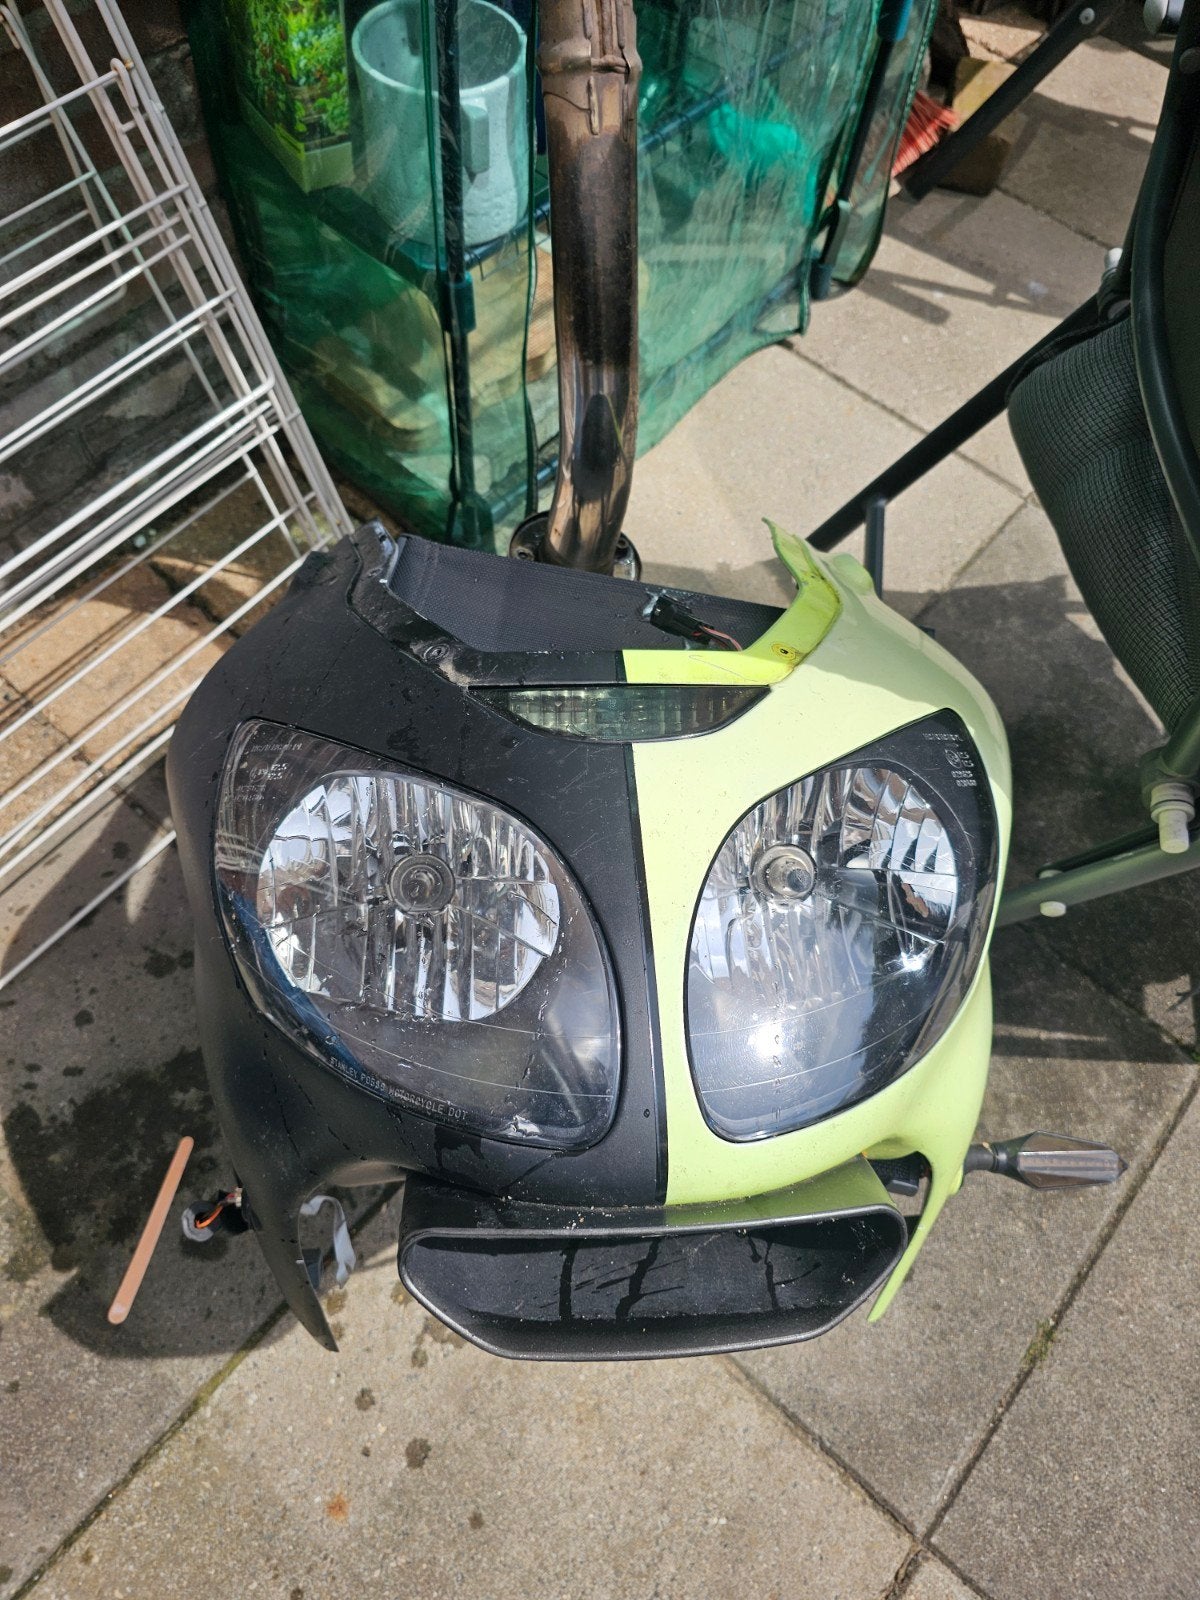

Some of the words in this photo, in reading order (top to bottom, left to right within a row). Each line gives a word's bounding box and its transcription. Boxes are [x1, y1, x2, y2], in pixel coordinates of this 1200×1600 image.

[330, 1057, 357, 1078] STANLEY
[388, 1087, 444, 1114] MOTORCYCLE
[449, 1106, 468, 1120] DOT
